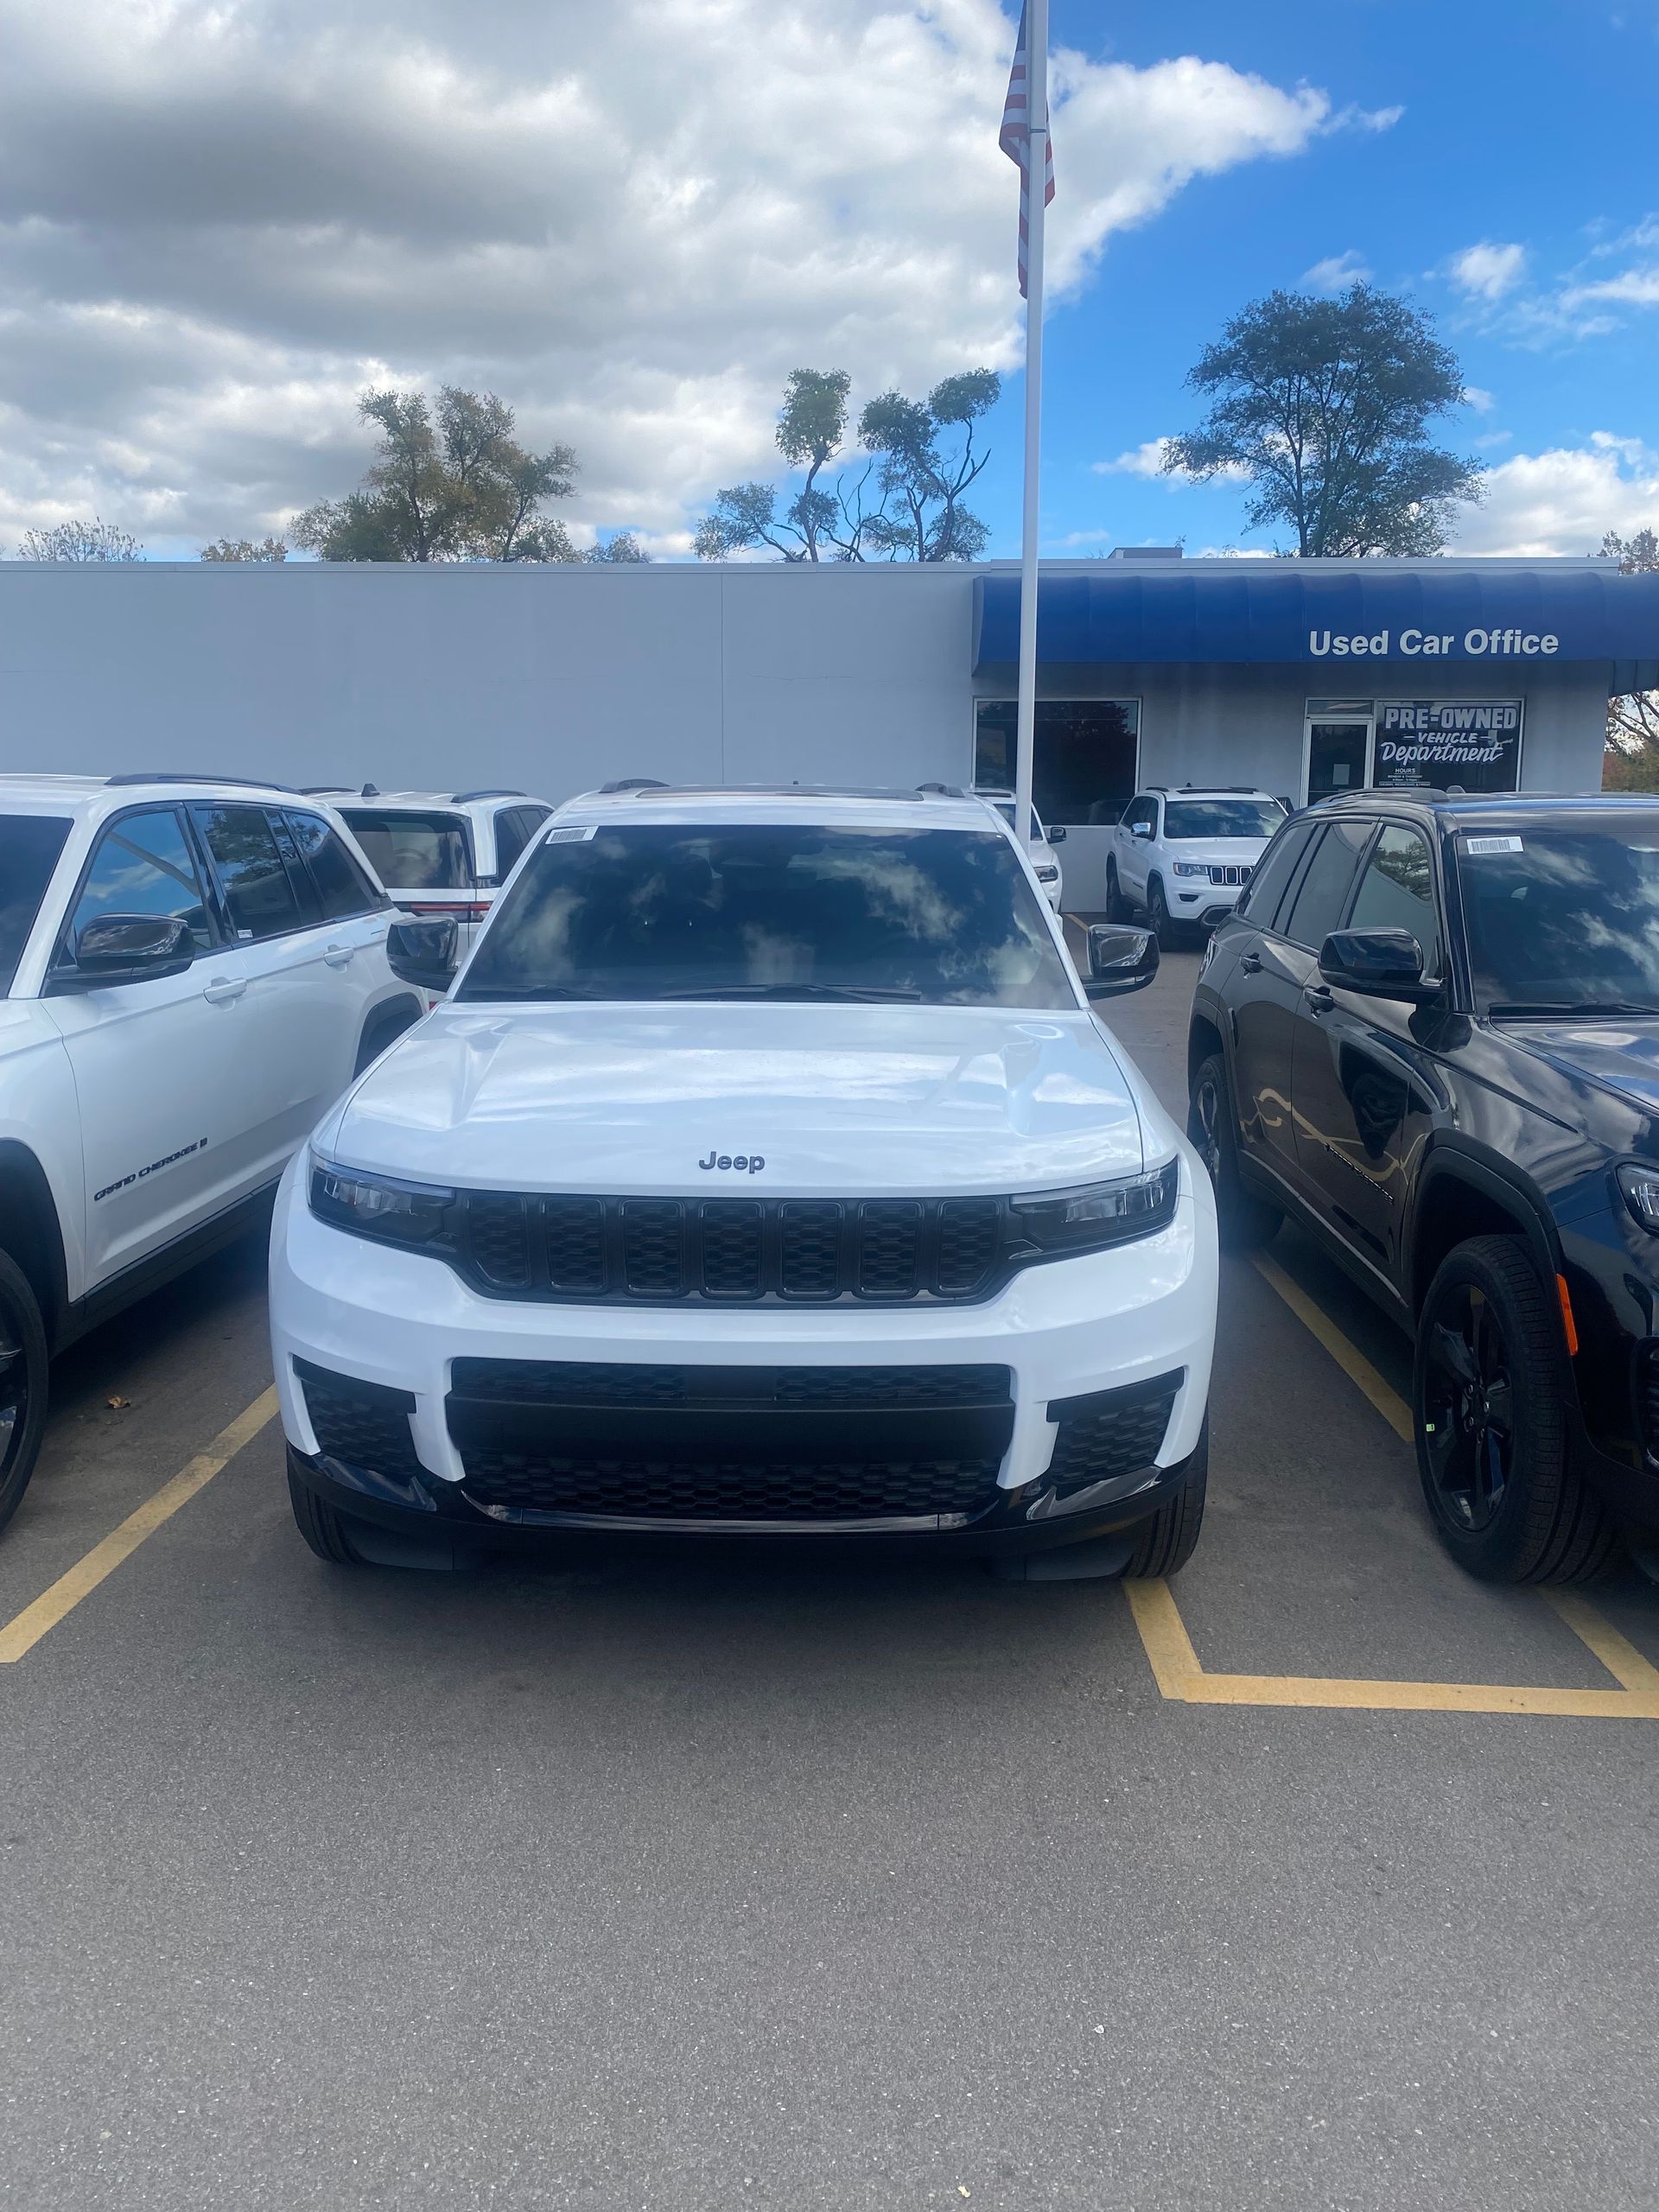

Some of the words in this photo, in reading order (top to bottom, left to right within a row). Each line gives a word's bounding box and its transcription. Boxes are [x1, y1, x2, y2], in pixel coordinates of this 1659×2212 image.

[1309, 630, 1389, 656] Used
[1399, 629, 1454, 655] Car
[1464, 628, 1559, 654] Office
[1385, 708, 1517, 729] PRE-OWNED
[1418, 732, 1478, 743] VEHICLE
[1381, 741, 1504, 766] Department
[93, 1173, 136, 1202] GRAND
[138, 1141, 198, 1178] CHEROKEE
[698, 1151, 766, 1173] Jeep
